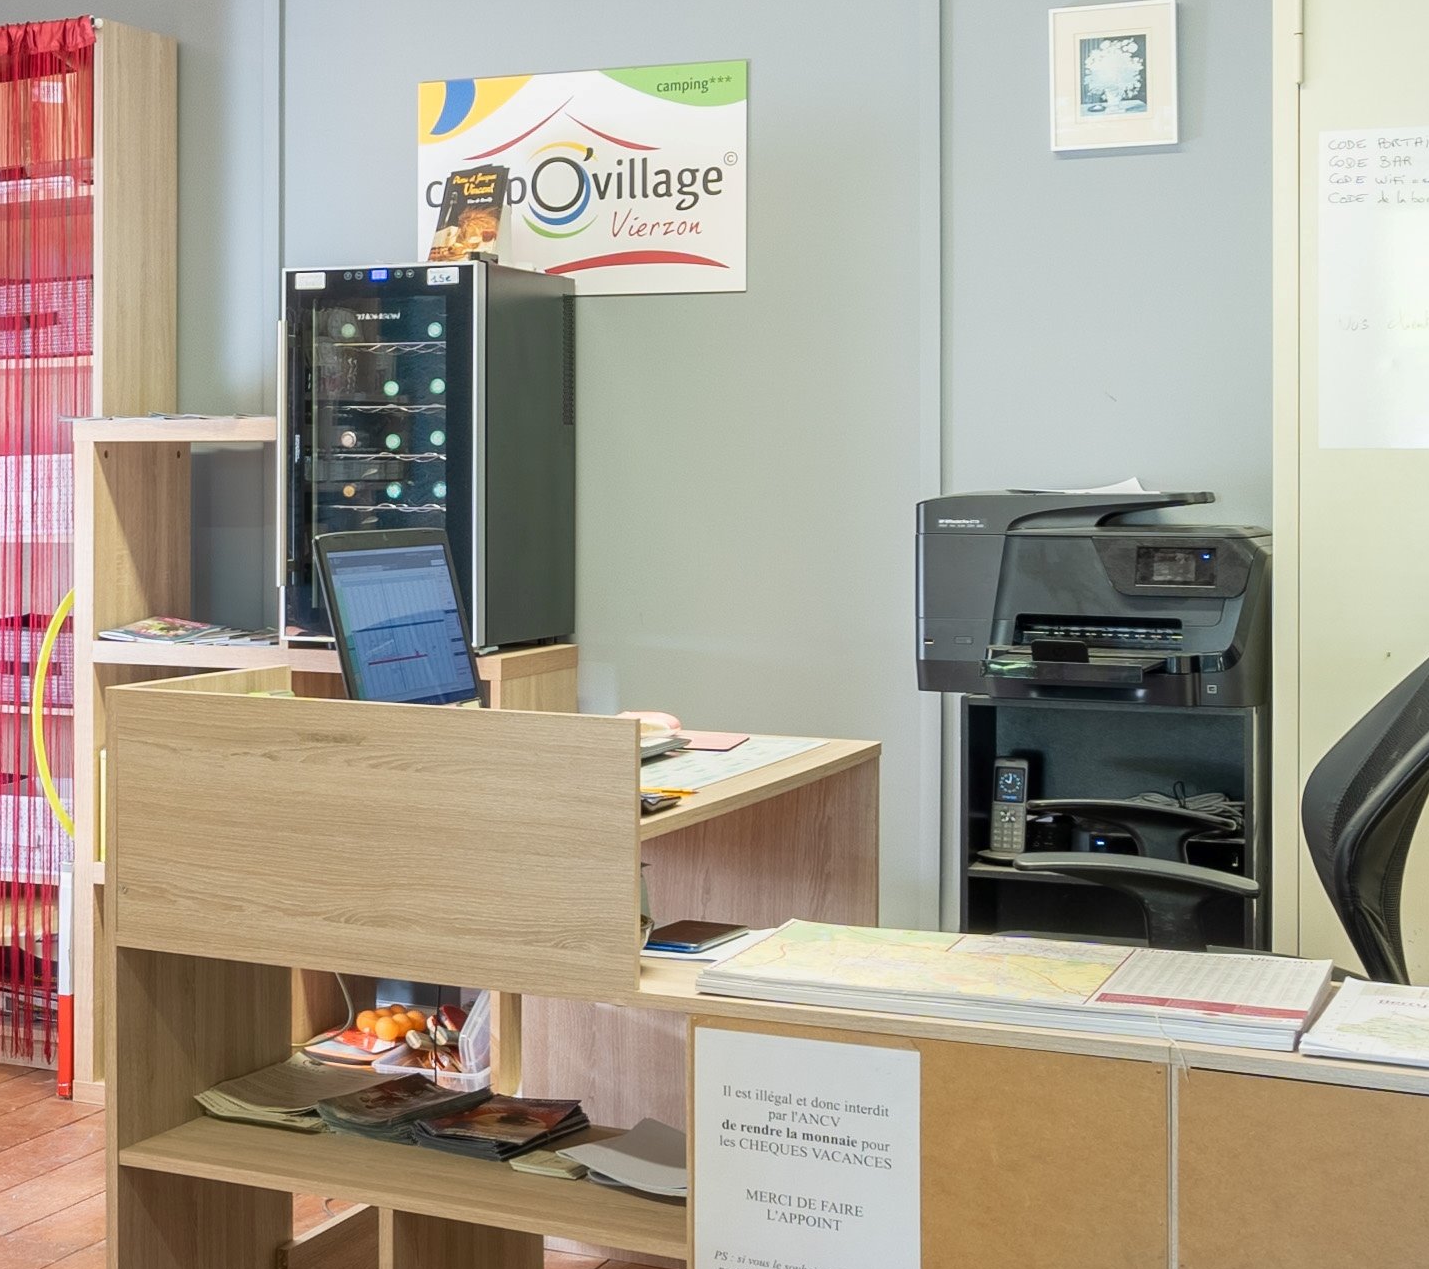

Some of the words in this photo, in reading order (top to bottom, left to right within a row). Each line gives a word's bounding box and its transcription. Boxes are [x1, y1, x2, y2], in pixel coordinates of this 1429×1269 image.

[1328, 138, 1367, 151] CODE
[1328, 155, 1369, 168] CODE
[1328, 173, 1365, 185] CODE
[1327, 193, 1369, 204] CODE
[613, 208, 703, 237] Vierzon
[723, 1084, 732, 1098] Il
[735, 1088, 752, 1100] est
[755, 1089, 793, 1107] illégal
[796, 1097, 807, 1107] et
[811, 1096, 841, 1112] donc
[845, 1099, 890, 1118] interdit
[768, 1110, 788, 1123] par
[791, 1110, 841, 1128] l'ANCV
[721, 1118, 737, 1131] de
[740, 1122, 783, 1138] rendre
[786, 1127, 798, 1140] la
[801, 1131, 858, 1148] monnaie
[861, 1139, 891, 1153] pour
[719, 1134, 736, 1148] les
[739, 1137, 809, 1158] CHEQUES
[812, 1147, 893, 1170] VACANCES
[745, 1187, 792, 1208] MERCI
[796, 1196, 817, 1211] DE
[820, 1200, 864, 1218] FAIRE
[766, 1208, 843, 1232] L'APPOINT
[714, 1249, 729, 1262] PS
[736, 1255, 746, 1265] si
[748, 1259, 770, 1269] vous
[773, 1258, 782, 1269] le
